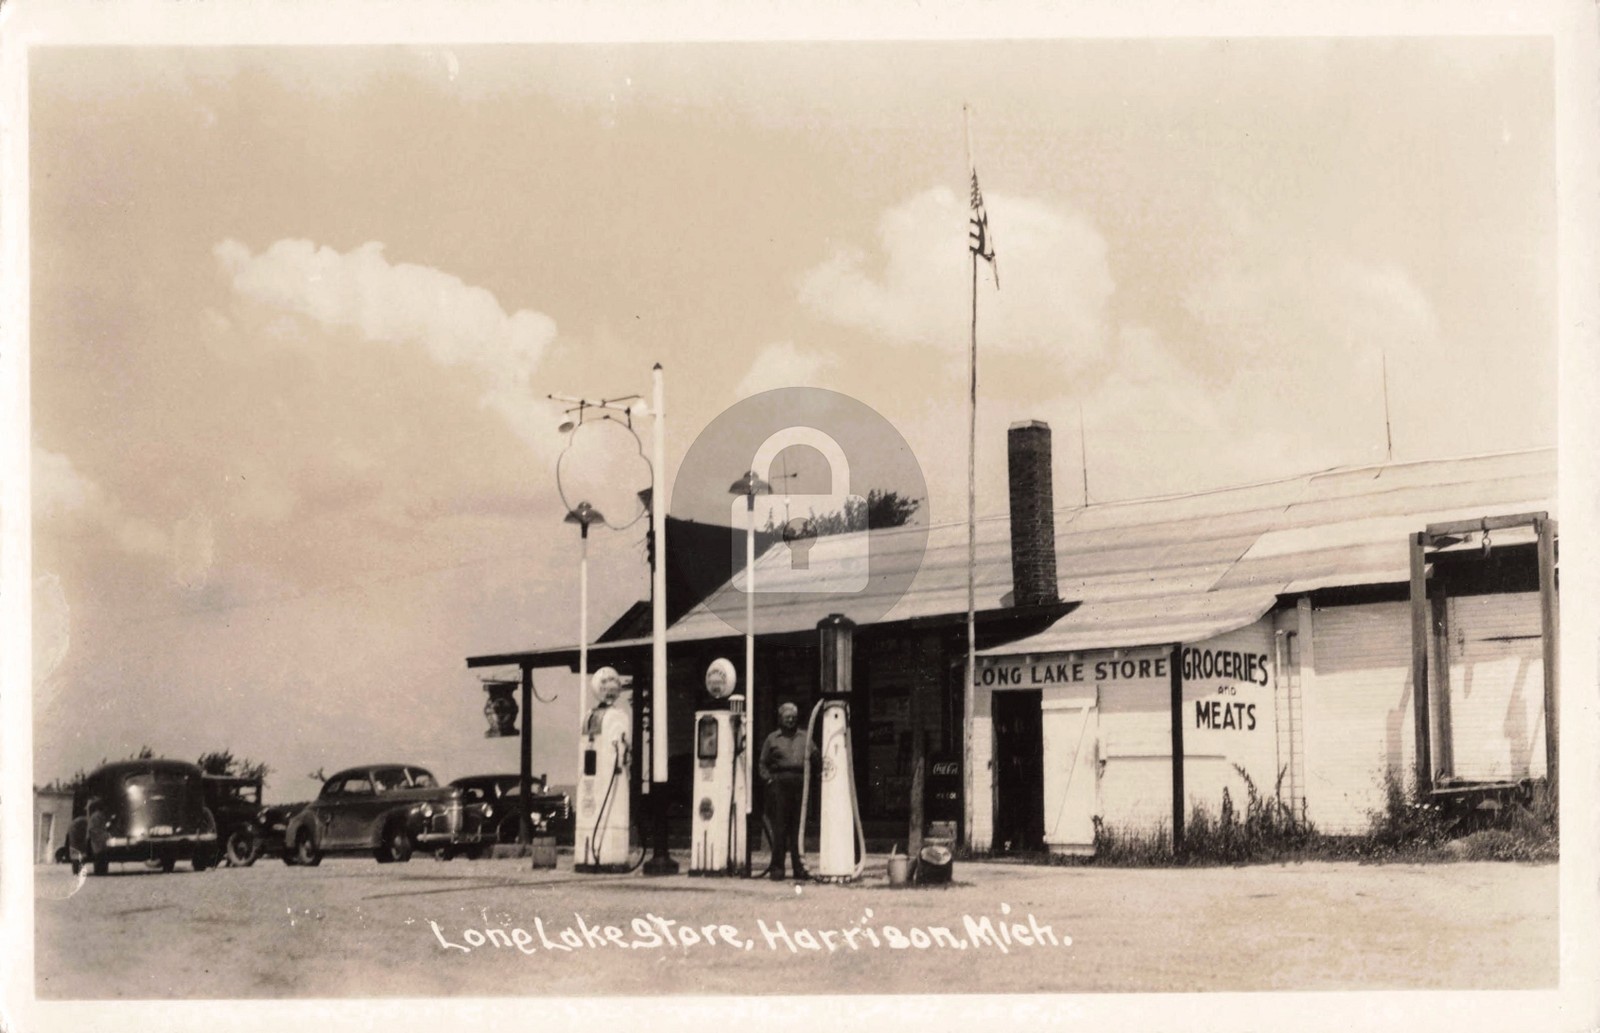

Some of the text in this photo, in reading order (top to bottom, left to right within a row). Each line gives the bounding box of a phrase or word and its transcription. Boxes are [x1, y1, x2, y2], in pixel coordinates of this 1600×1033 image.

[1031, 662, 1085, 685] LAKE
[1095, 657, 1168, 681] STORE
[1182, 647, 1269, 687] GROCERIES
[1196, 701, 1257, 731] MEATS
